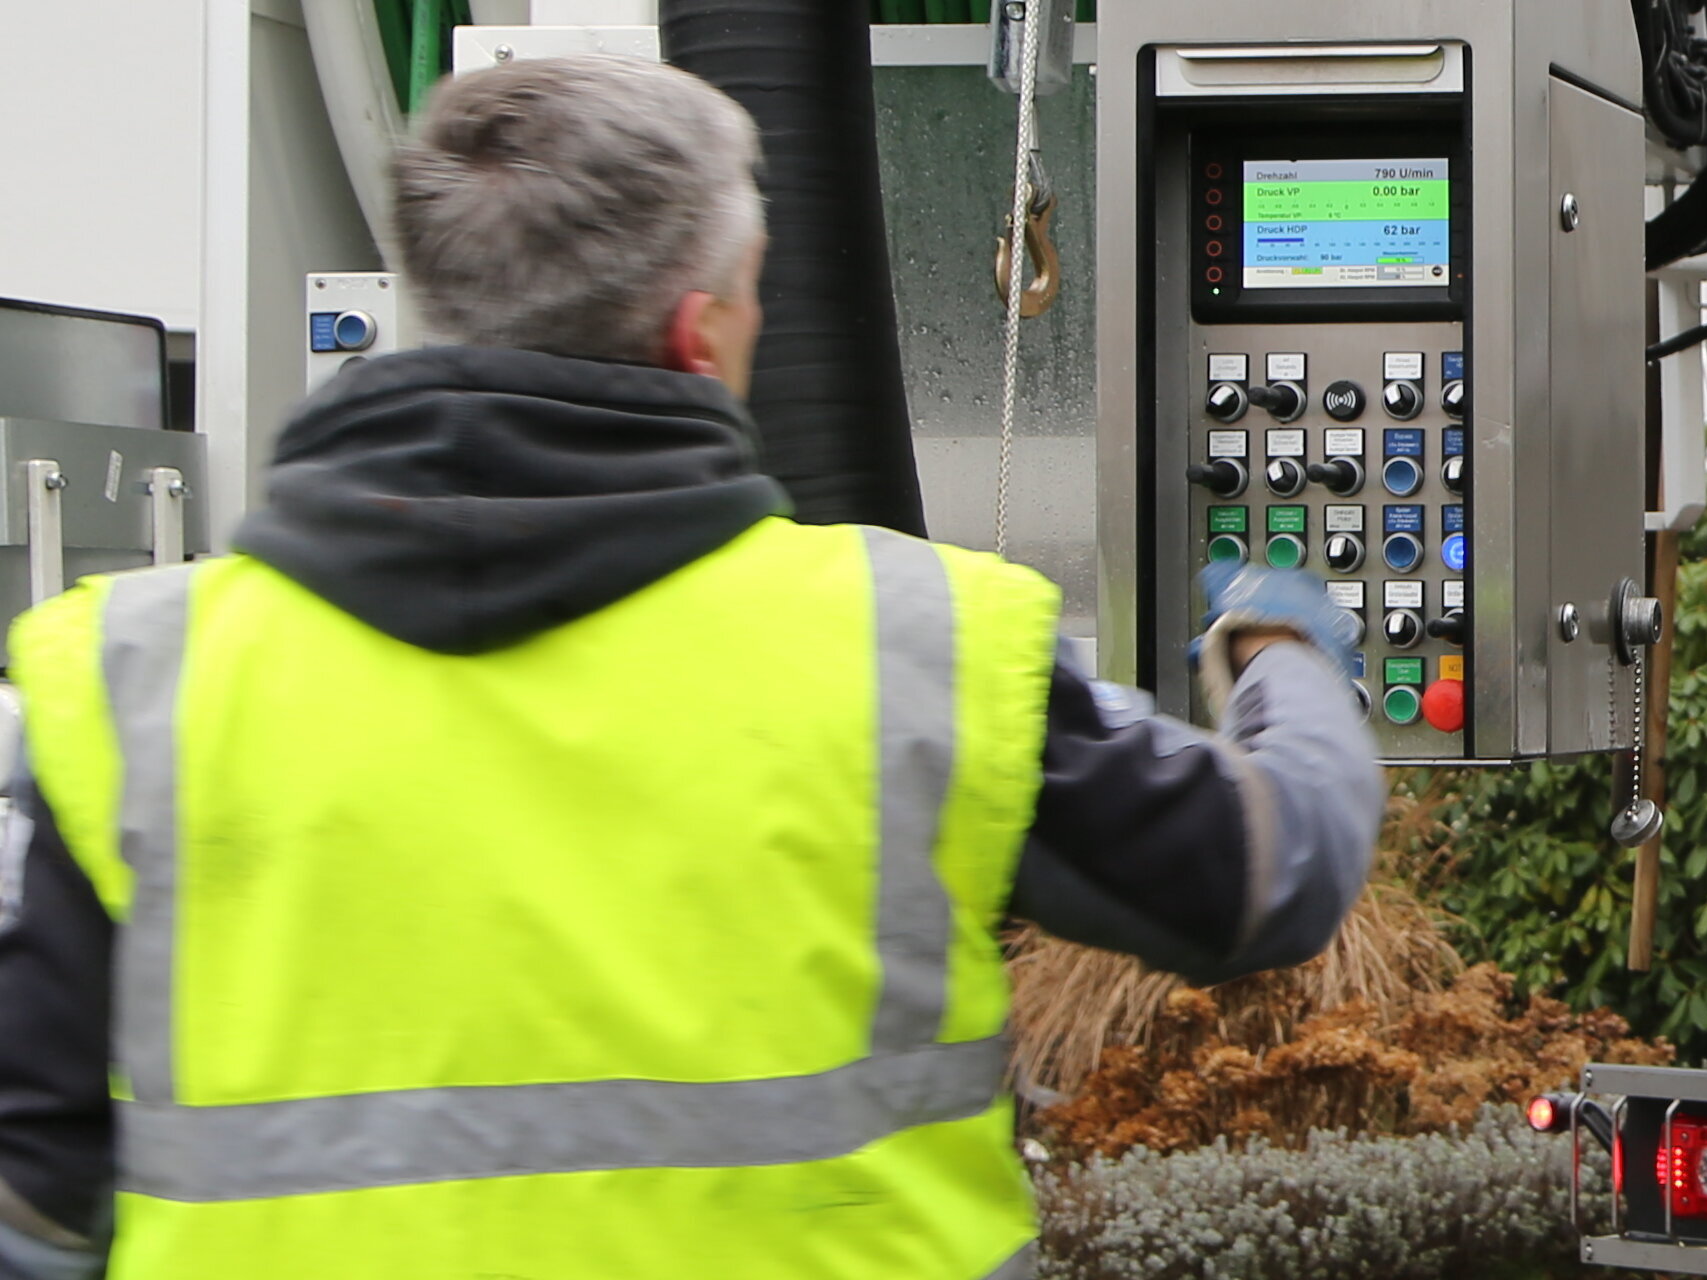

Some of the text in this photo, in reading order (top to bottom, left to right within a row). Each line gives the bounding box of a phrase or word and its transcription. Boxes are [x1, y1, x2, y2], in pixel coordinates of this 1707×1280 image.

[1256, 167, 1434, 181] Drehzahl 790 U/min
[1257, 185, 1421, 197] Druck VP 0.00 bar
[1257, 224, 1422, 236] Druck HDP 62 bar
